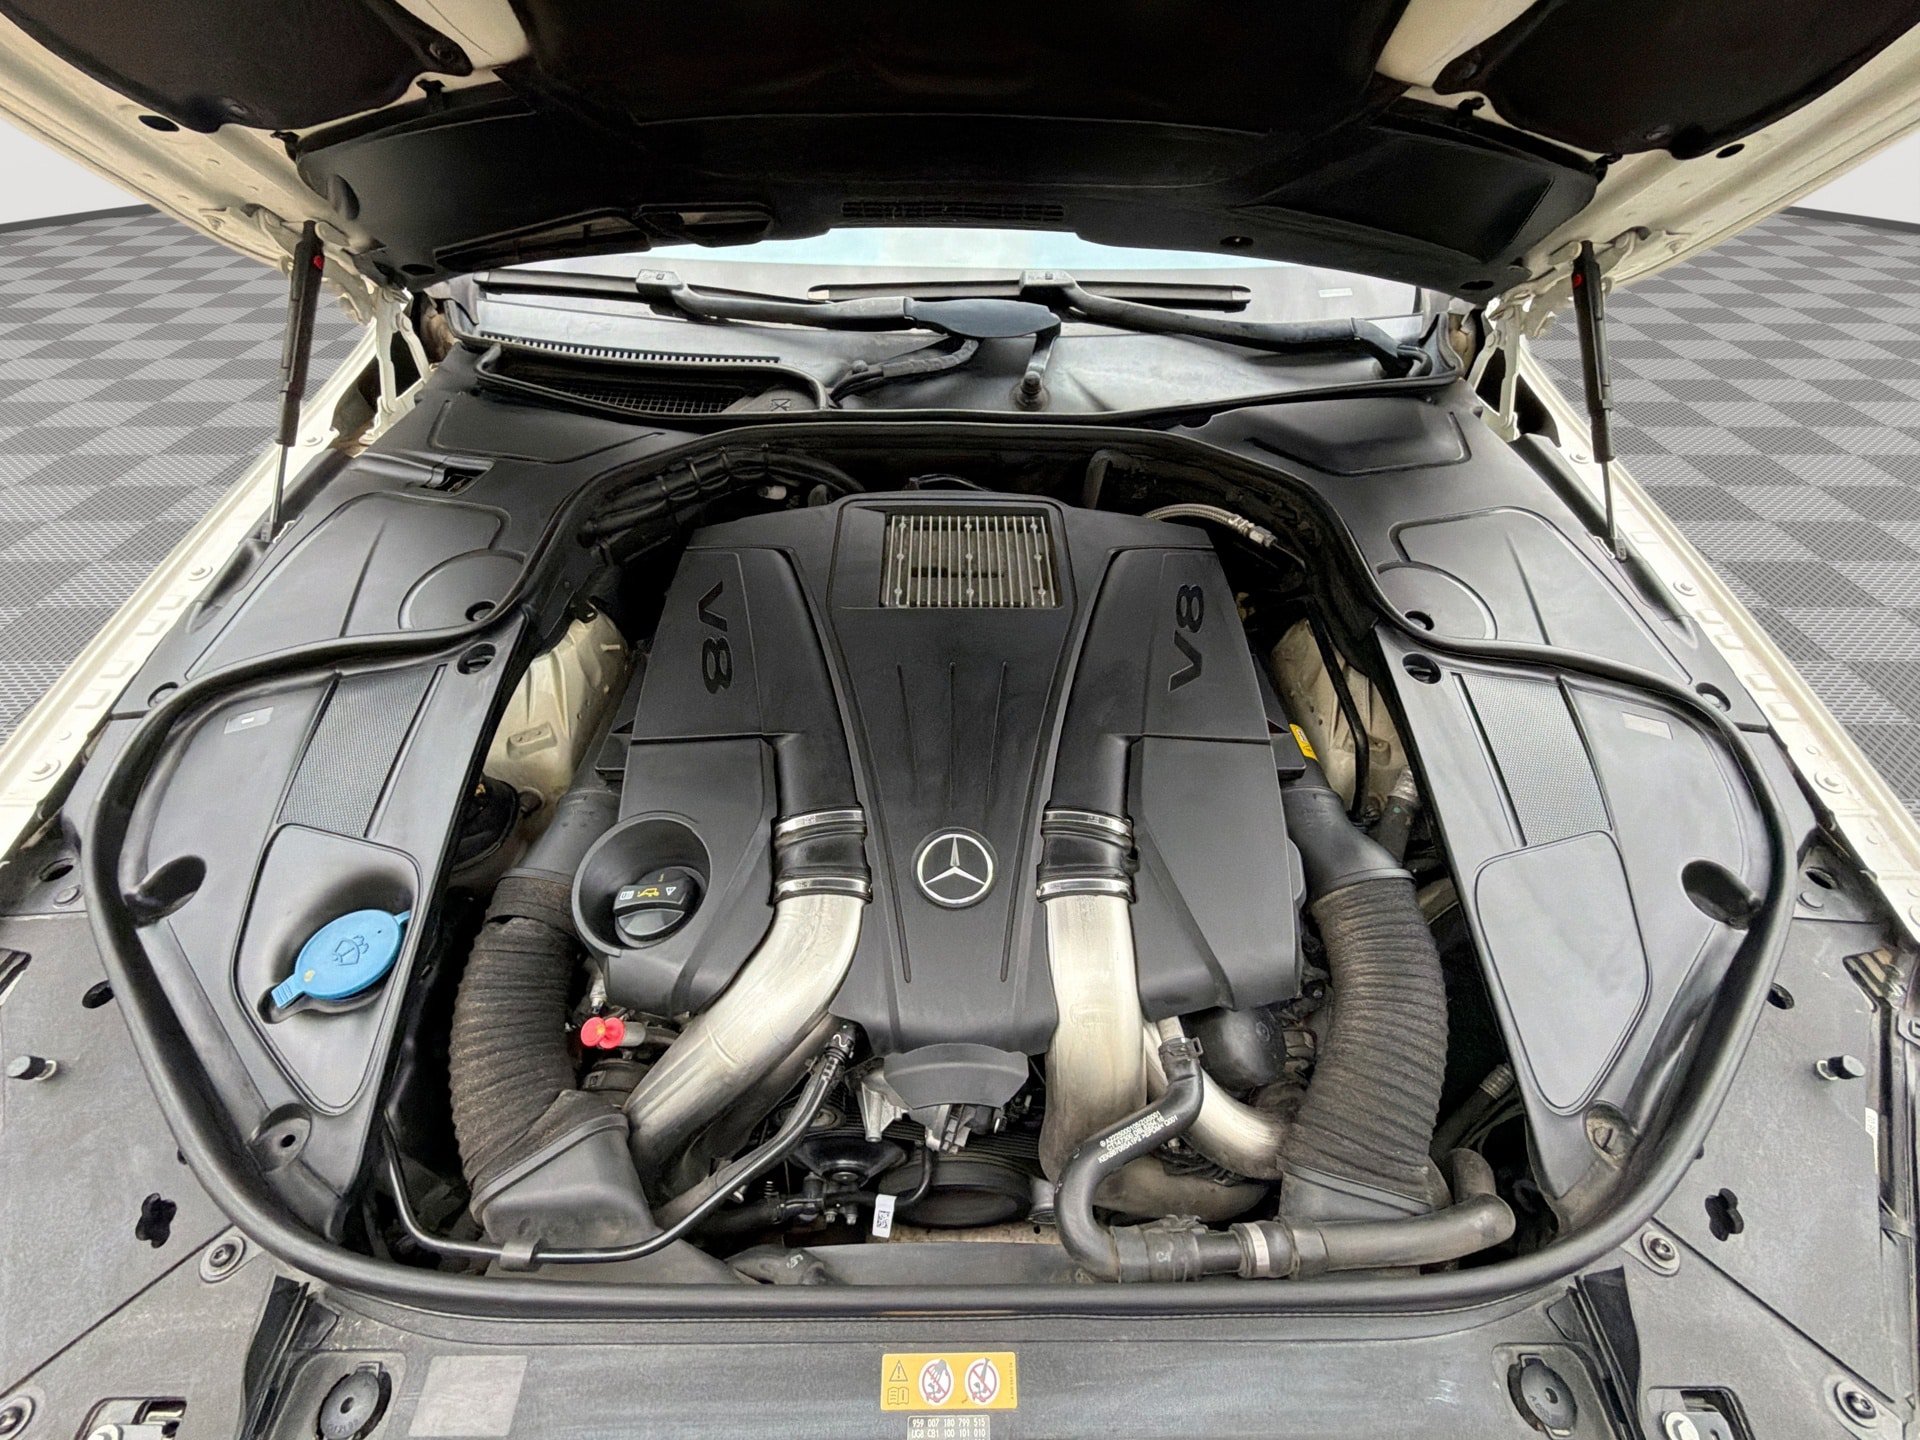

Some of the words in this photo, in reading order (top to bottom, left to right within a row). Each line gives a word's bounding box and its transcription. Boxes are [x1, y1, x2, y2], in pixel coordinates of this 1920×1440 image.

[697, 580, 733, 693] V8
[1167, 584, 1204, 692] V8
[974, 1418, 986, 1428] 515
